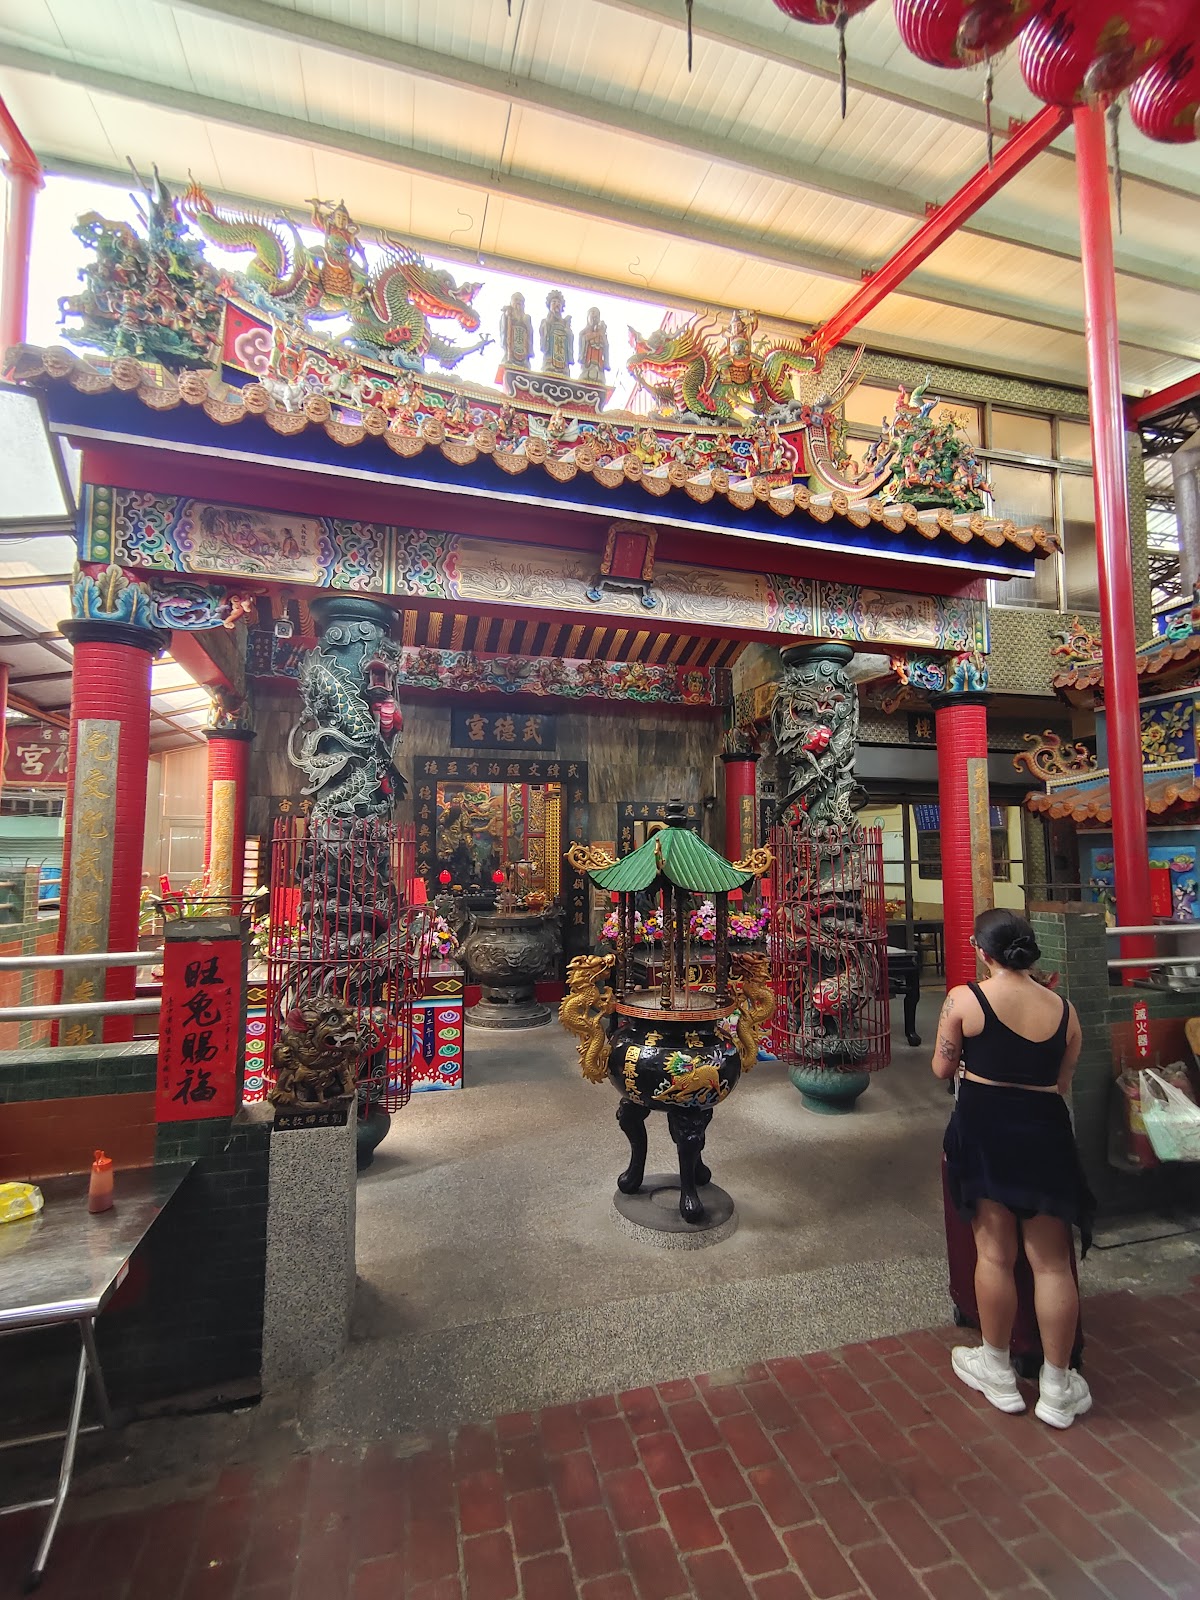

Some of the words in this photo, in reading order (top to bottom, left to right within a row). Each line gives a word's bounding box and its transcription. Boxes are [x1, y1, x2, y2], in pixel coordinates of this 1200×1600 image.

[171, 956, 225, 1105] 旺兔賜福
[1135, 1008, 1148, 1046] 滅火器
